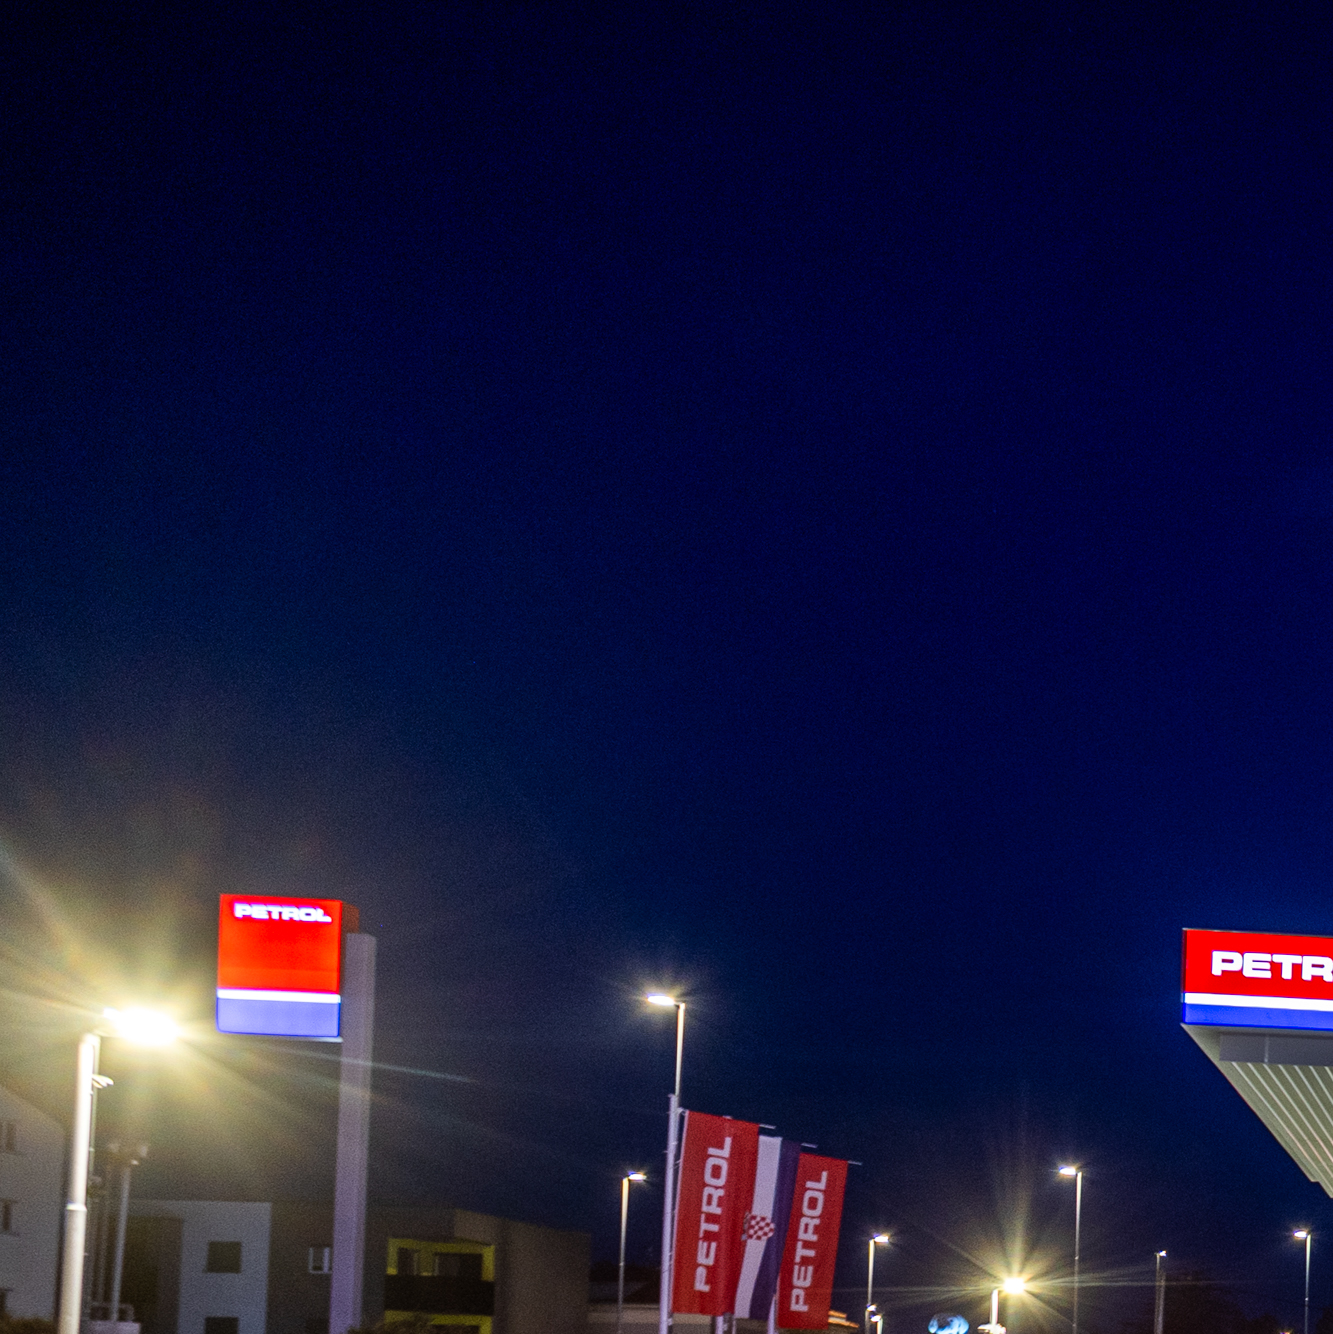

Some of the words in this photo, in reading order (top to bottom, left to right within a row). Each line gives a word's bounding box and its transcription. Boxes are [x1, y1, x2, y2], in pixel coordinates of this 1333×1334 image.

[234, 903, 332, 922] PETROL
[693, 1136, 733, 1293] PETROL
[790, 1170, 829, 1312] PETROL
